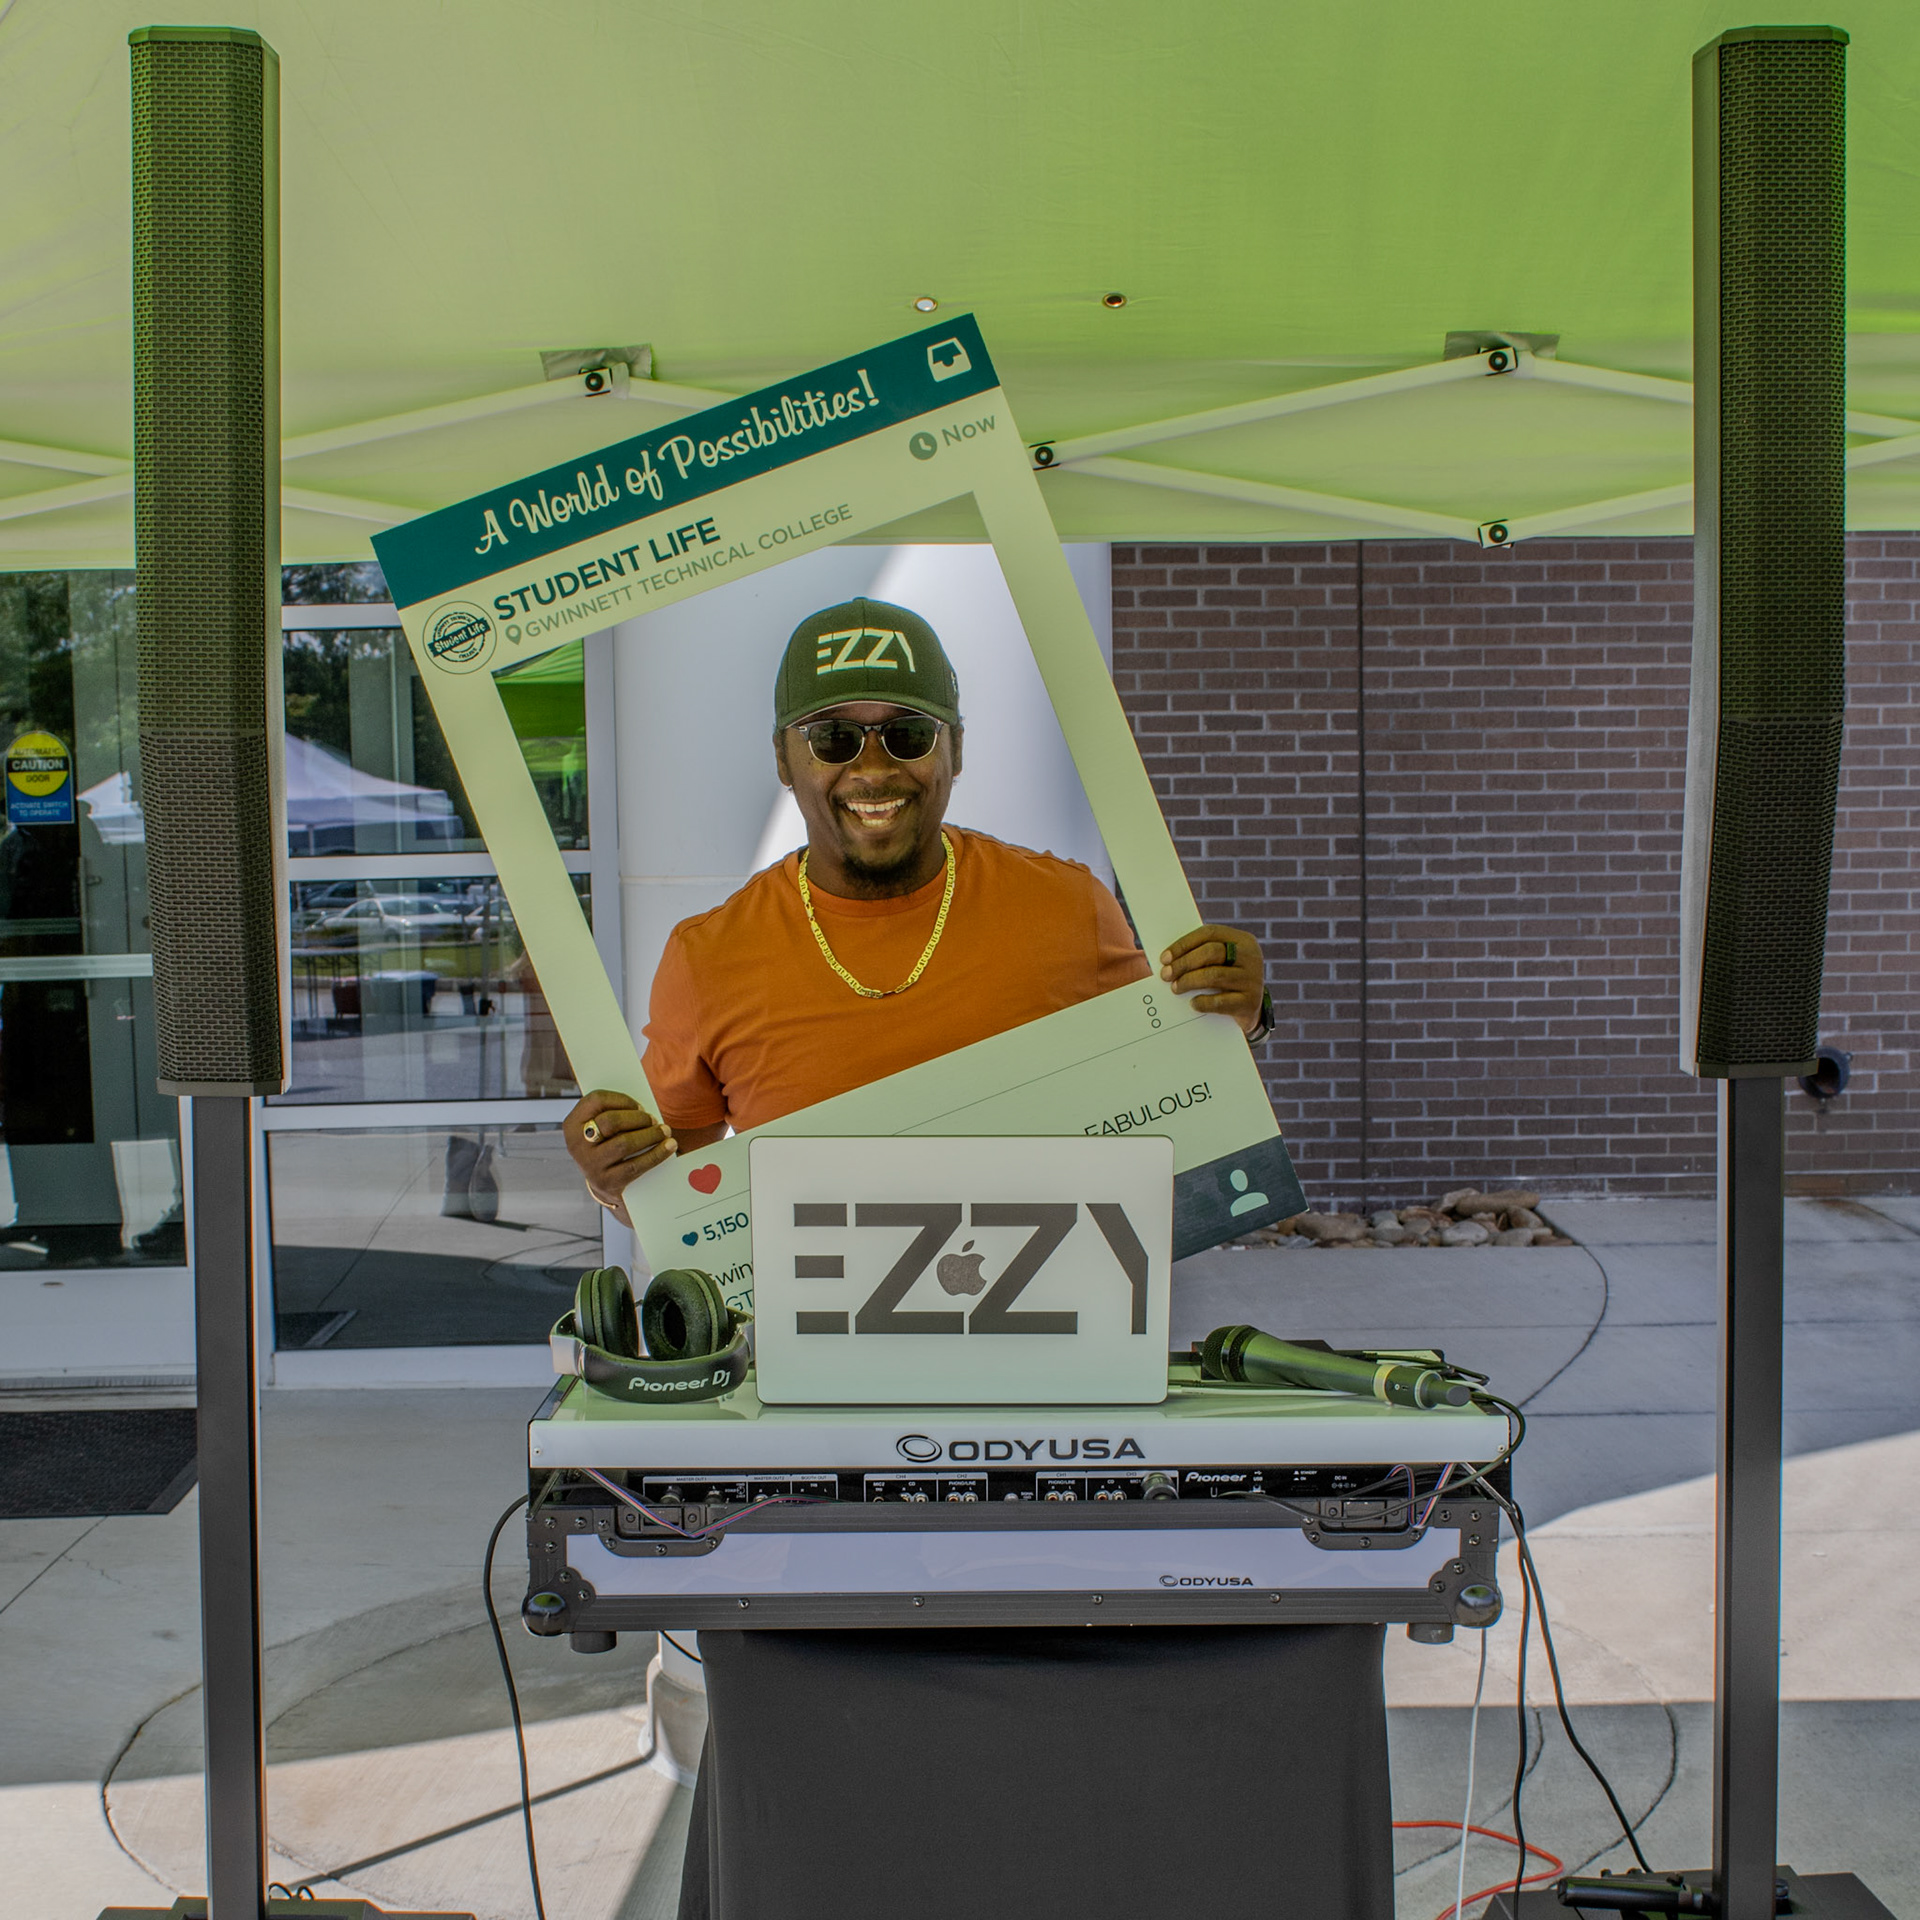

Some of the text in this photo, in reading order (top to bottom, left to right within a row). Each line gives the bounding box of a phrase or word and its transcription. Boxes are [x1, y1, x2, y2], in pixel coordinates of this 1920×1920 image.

[941, 415, 996, 447] Now
[475, 368, 880, 555] A World of Possibilities!
[493, 516, 721, 621] STUDENT LIFE
[525, 502, 854, 638] GWINNETT TECHNICAL COLLEGE
[433, 629, 469, 653] Student
[466, 621, 487, 637] Life
[816, 627, 916, 675] EZZY
[11, 759, 64, 771] CAUTION
[25, 774, 51, 783] DOOR
[702, 1211, 750, 1241] 5,150
[793, 1202, 1150, 1335] EZZY
[628, 1369, 731, 1392] Pioneer DJ
[949, 1437, 1147, 1461] ODYUSA
[1184, 1471, 1247, 1483] Pioneer
[1179, 1577, 1254, 1586] ODYUSA
